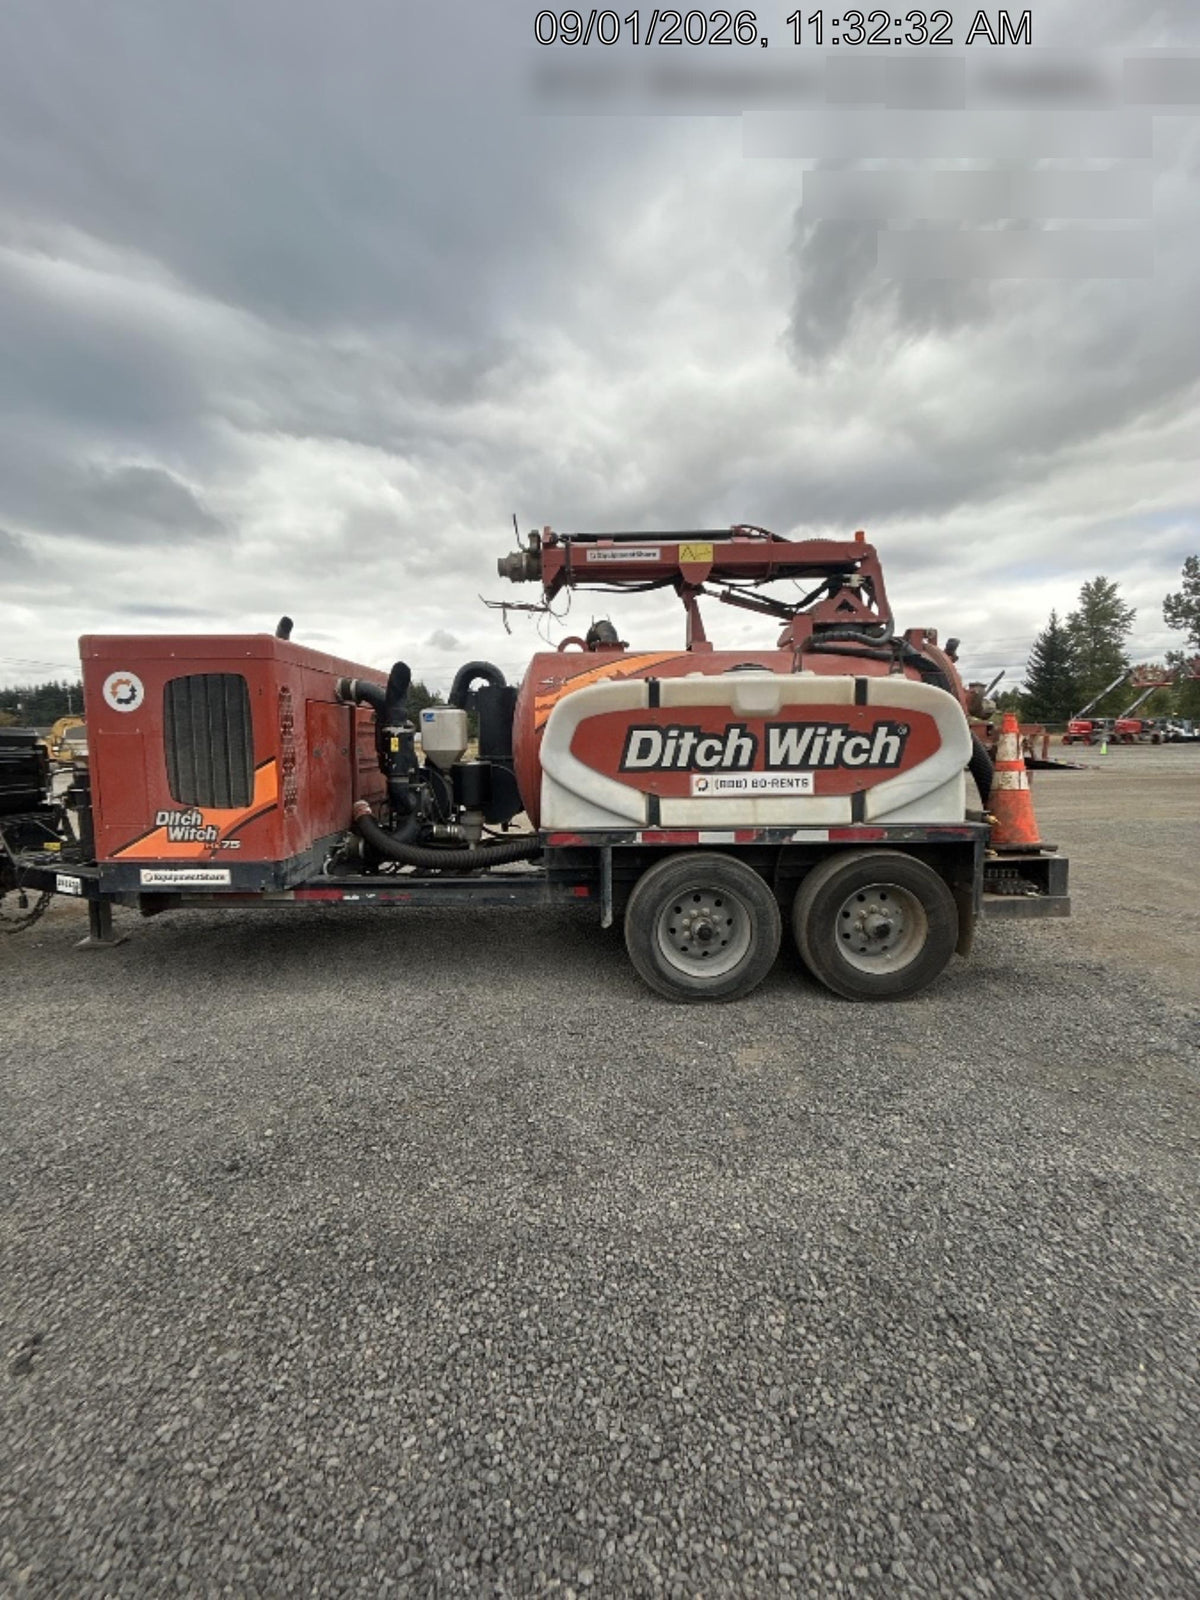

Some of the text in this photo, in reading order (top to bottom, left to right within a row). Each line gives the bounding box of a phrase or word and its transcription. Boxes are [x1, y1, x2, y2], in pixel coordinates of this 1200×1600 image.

[624, 726, 901, 768] Ditch Witch
[155, 810, 203, 826] Ditch
[167, 825, 218, 842] Witch
